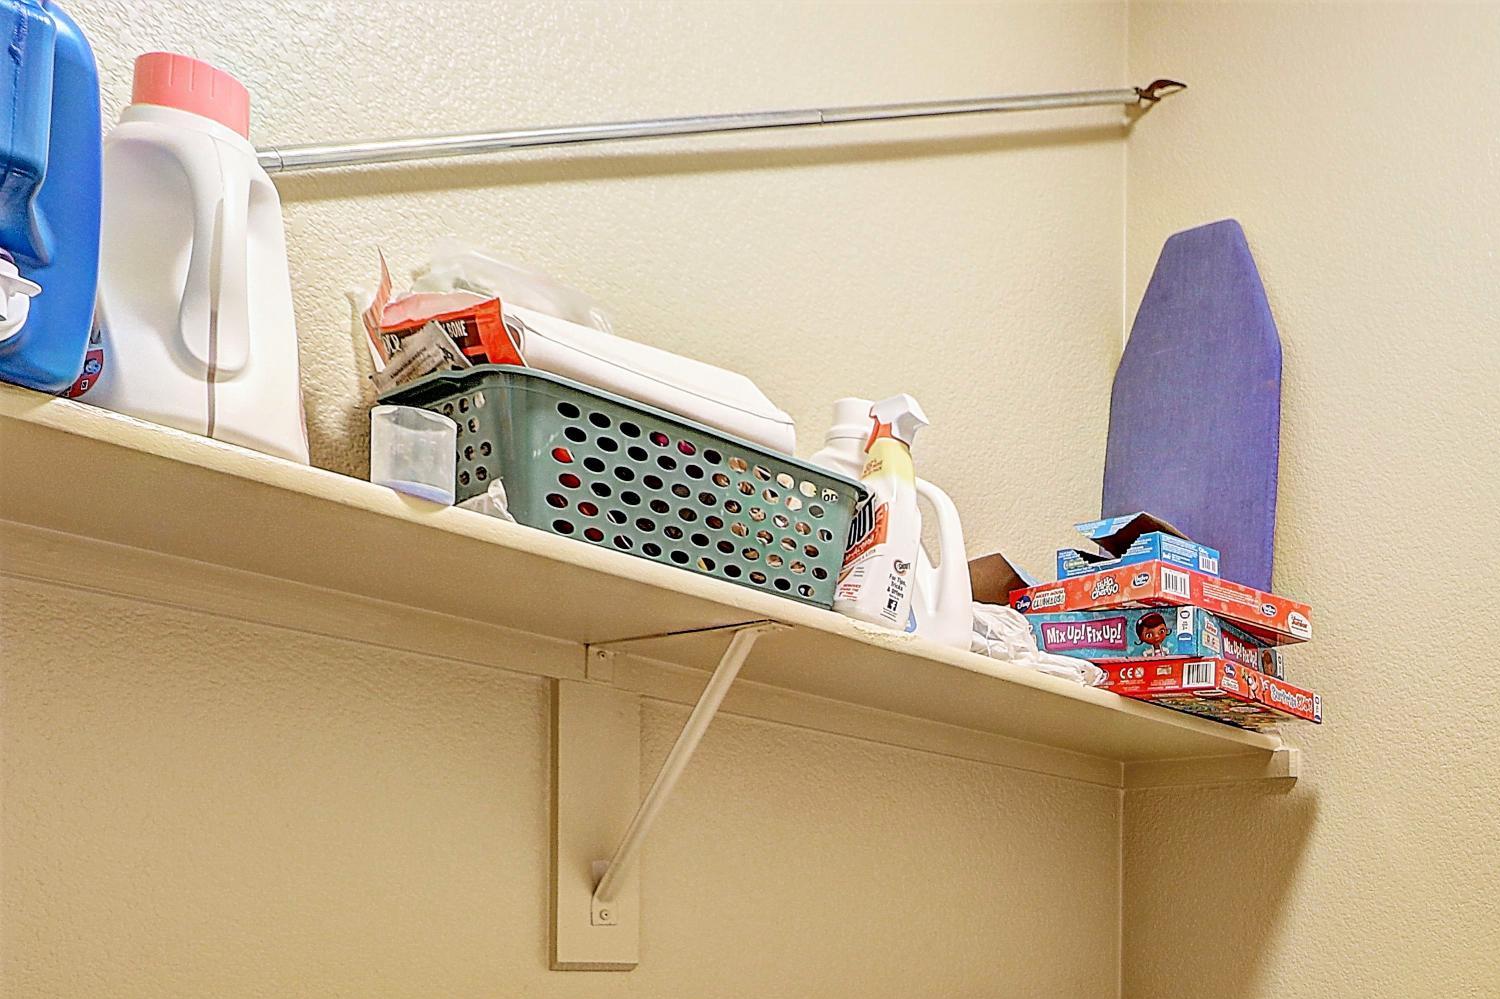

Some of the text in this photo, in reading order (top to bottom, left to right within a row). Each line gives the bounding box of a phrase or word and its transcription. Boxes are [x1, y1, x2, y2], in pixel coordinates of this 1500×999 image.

[1046, 622, 1122, 645] Mix Up! Fix Up!
